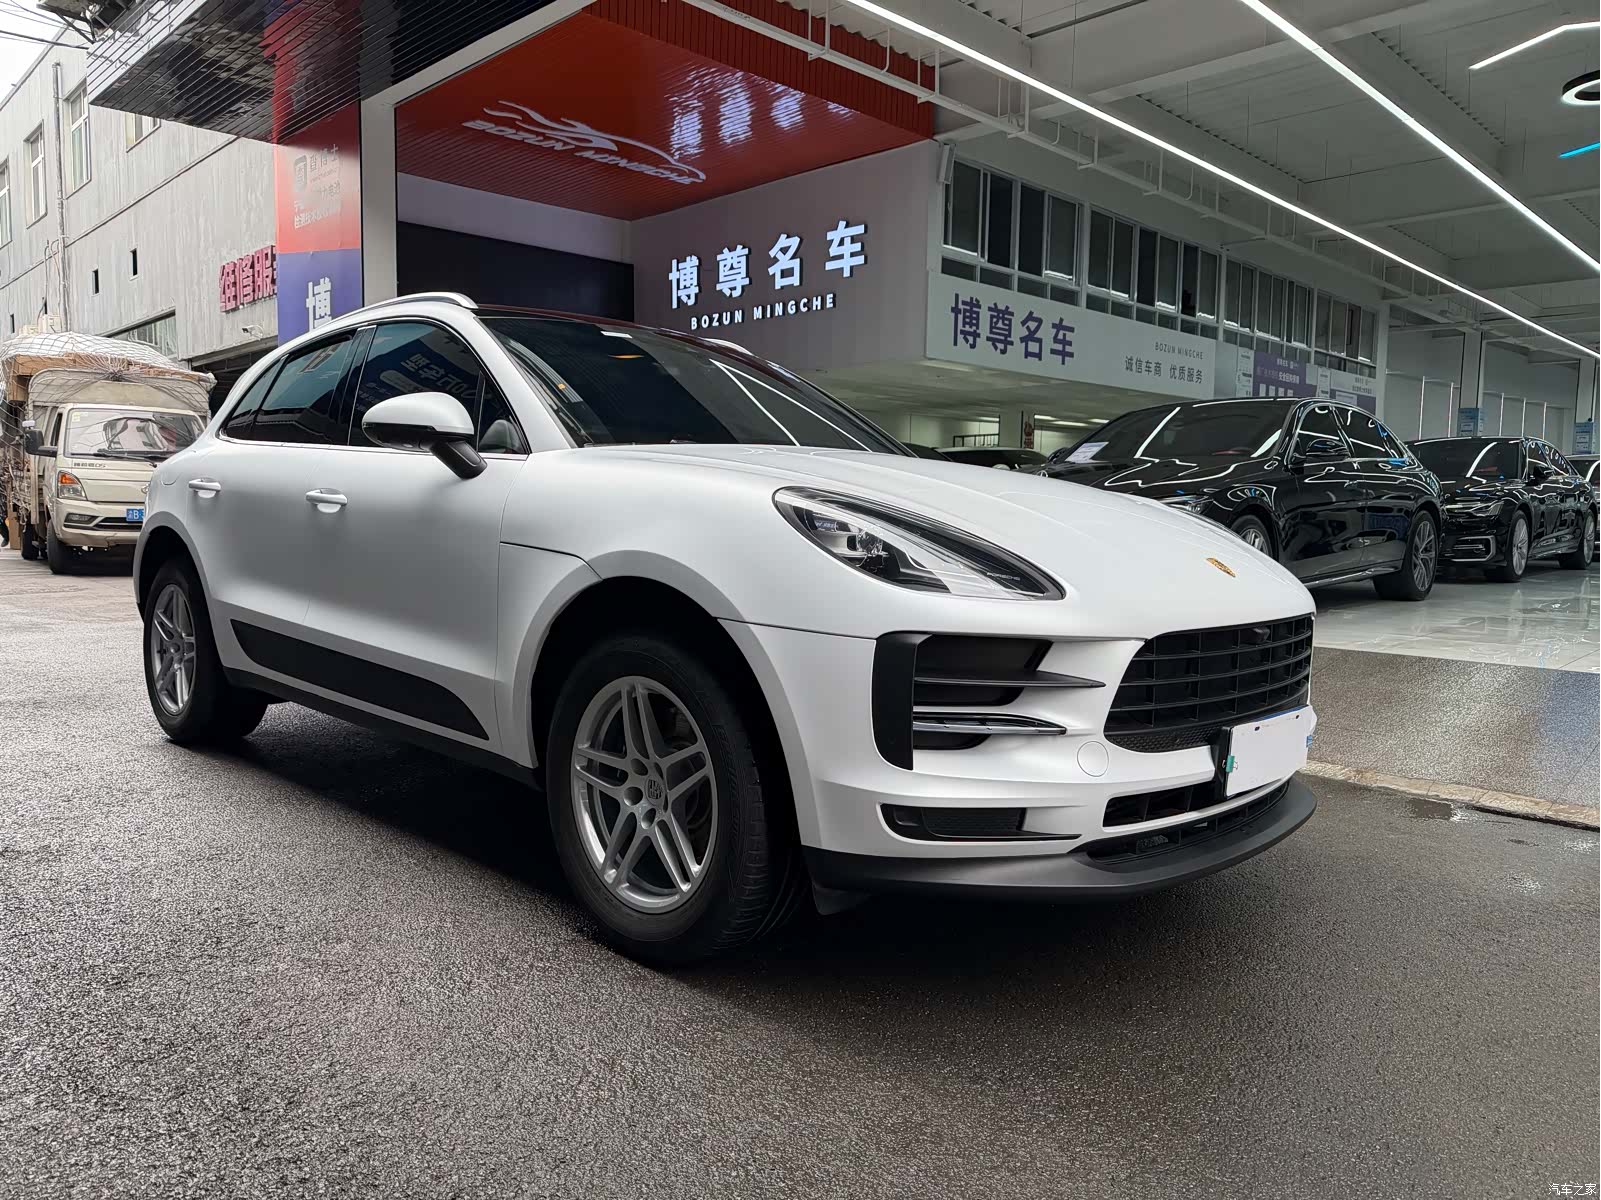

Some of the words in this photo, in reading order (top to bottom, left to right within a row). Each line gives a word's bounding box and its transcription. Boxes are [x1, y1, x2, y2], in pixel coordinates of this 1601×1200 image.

[219, 245, 277, 312] 维修服
[668, 220, 865, 309] 博尊名车
[690, 309, 743, 330] BOZUN
[753, 293, 834, 320] MINGCHE
[950, 292, 1075, 366] 博尊名车
[1125, 355, 1162, 378] 诚信车商
[1169, 363, 1203, 385] 优质服务
[1154, 341, 1176, 354] BOZUN
